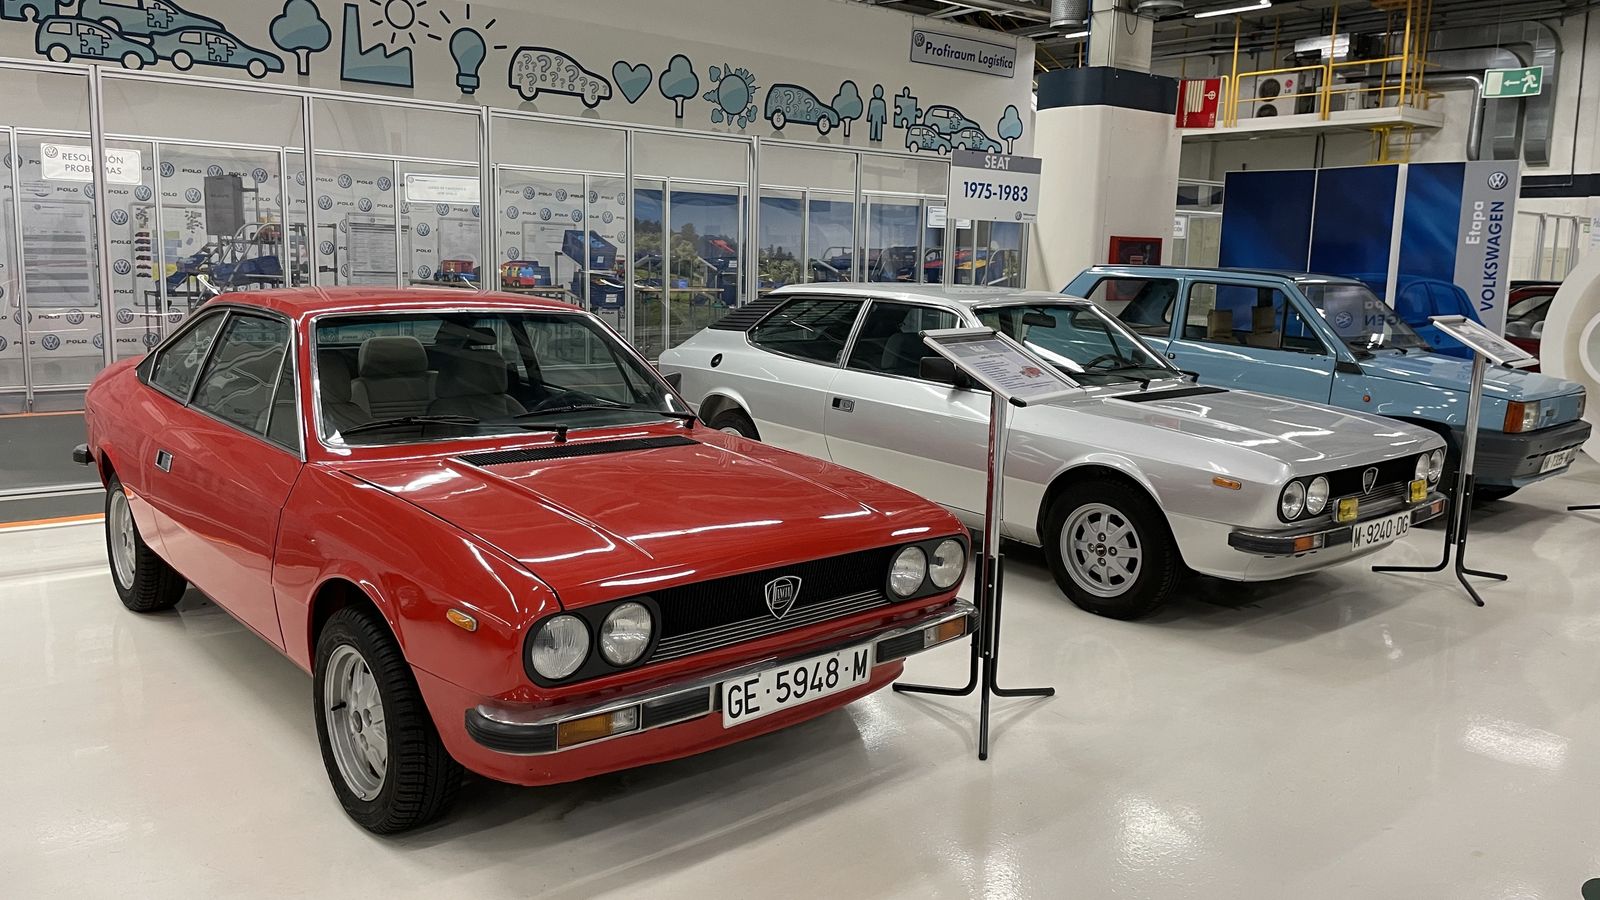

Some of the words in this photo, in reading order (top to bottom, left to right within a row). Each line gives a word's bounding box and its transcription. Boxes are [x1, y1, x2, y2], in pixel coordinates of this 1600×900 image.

[925, 41, 976, 62] Profiraum
[978, 50, 1013, 69] Logística
[984, 155, 1011, 170] SEAT
[963, 181, 1028, 202] 1975-1983
[1465, 201, 1486, 245] Etapa
[1479, 201, 1505, 312] VOLKSWAGEN
